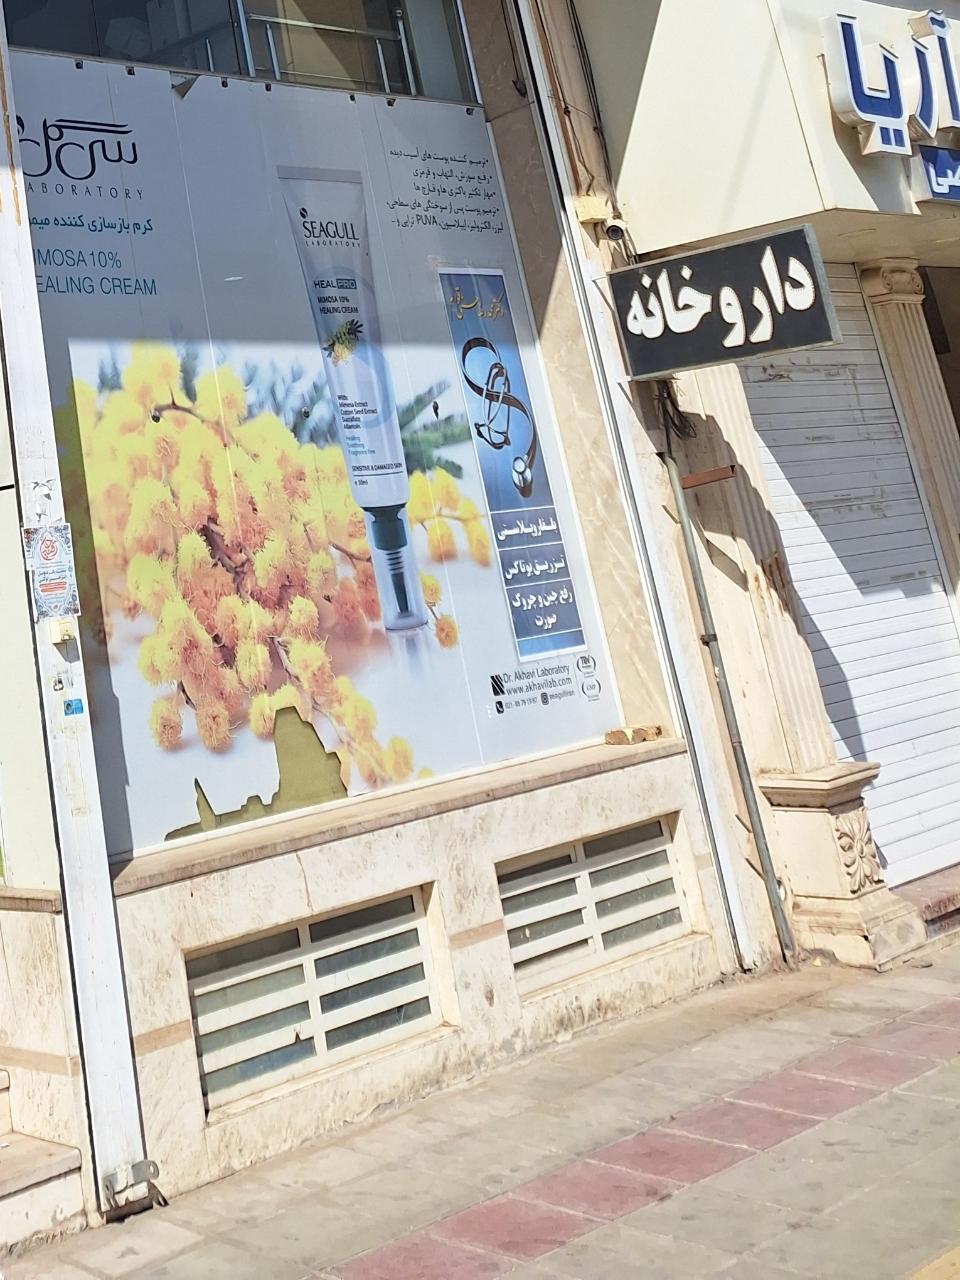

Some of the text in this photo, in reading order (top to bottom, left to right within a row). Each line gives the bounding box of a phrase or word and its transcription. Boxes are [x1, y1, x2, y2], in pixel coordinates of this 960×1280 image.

[27, 183, 143, 200] ABORATORY
[31, 215, 153, 234] کرم بازسازی کننده میم
[416, 214, 438, 226] PUVA
[302, 220, 360, 240] SEAGULL
[33, 249, 122, 269] IMOSA 10%
[37, 275, 157, 296] EALING CREAM
[313, 279, 336, 289] HEAL
[626, 245, 816, 348] داروخانه
[505, 554, 566, 579] تزریق بوتاکس
[512, 592, 537, 610] چروک
[543, 591, 558, 607] چین
[559, 585, 573, 604] رفع
[534, 613, 557, 629] صورت
[503, 673, 514, 683] Dr.
[514, 669, 536, 681] Akhavi
[536, 664, 570, 678] Laboratory
[506, 676, 573, 695] www.akhavilab.com
